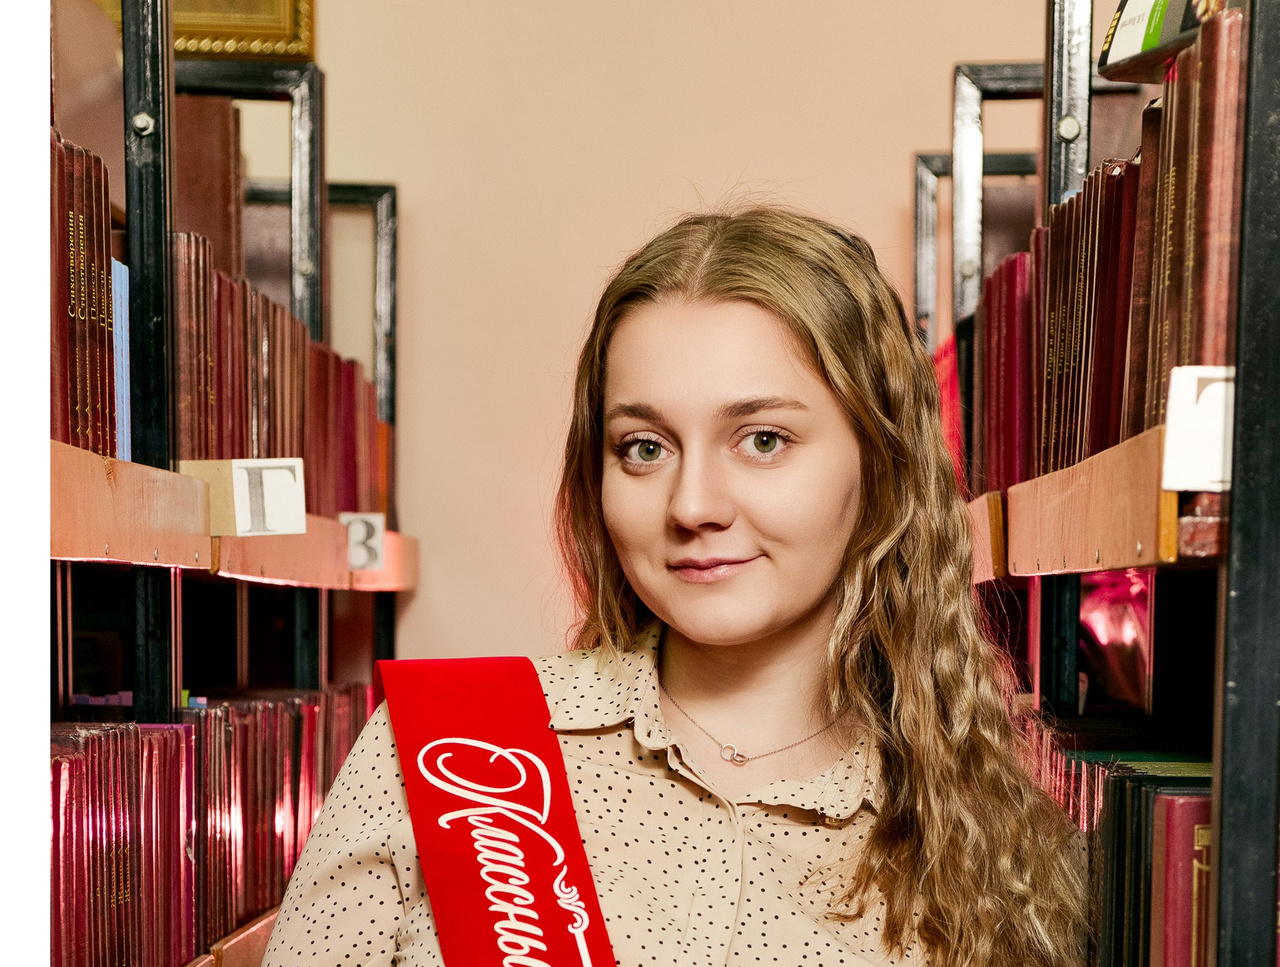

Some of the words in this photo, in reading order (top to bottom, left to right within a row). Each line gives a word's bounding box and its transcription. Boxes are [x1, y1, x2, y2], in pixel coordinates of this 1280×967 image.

[68, 211, 76, 318] Стихотворения
[78, 214, 86, 320] Стихотворения
[237, 464, 297, 533] Г
